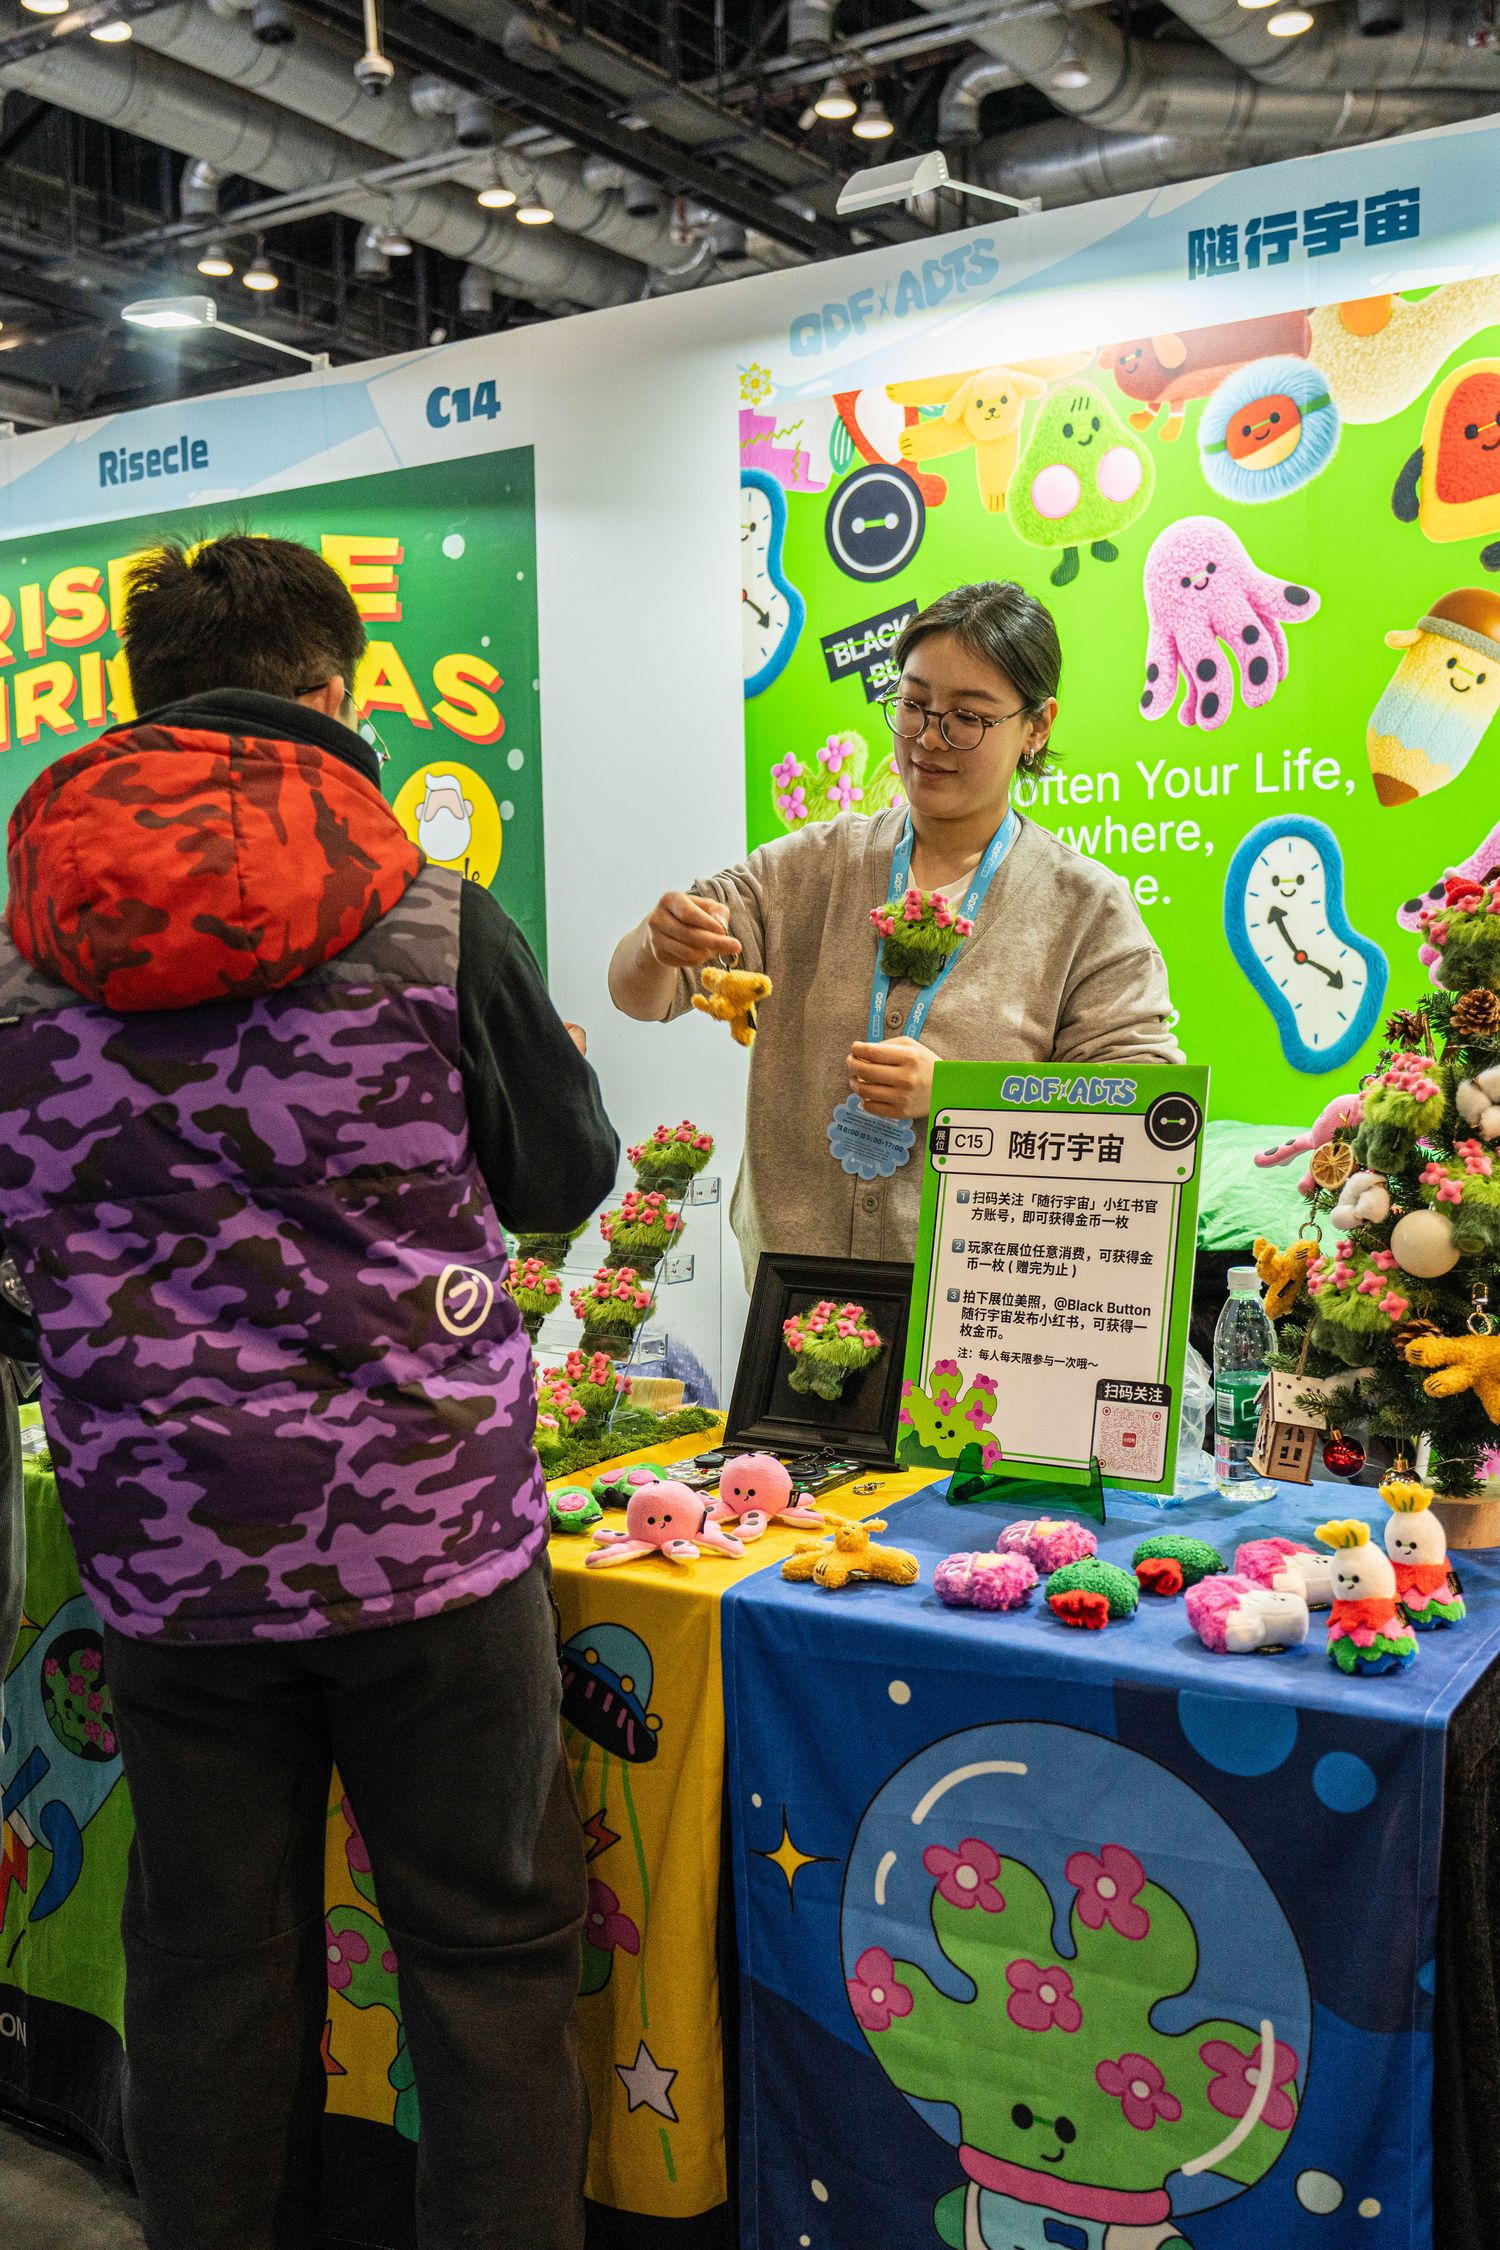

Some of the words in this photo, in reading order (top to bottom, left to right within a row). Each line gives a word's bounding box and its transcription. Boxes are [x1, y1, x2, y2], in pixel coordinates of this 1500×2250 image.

[1188, 187, 1420, 281] 随行宇宙
[426, 379, 502, 429] C14
[98, 435, 209, 488] Risecle
[1136, 758, 1239, 800] Your
[1255, 747, 1355, 797] Life,
[935, 1130, 946, 1151] 展位
[954, 1133, 984, 1149] C15
[1008, 1130, 1125, 1164] 随行宇宙
[971, 1207, 1129, 1230] 方账号，即可获得金币一枚
[968, 1240, 1154, 1266] 玩家在展位任意消费，可获得金
[961, 1307, 1148, 1334] 随行宇宙发布小红书，可获得一
[1107, 1302, 1151, 1317] Button
[959, 1324, 1005, 1341] 枚金币。
[1104, 1383, 1163, 1403] 扫码关注
